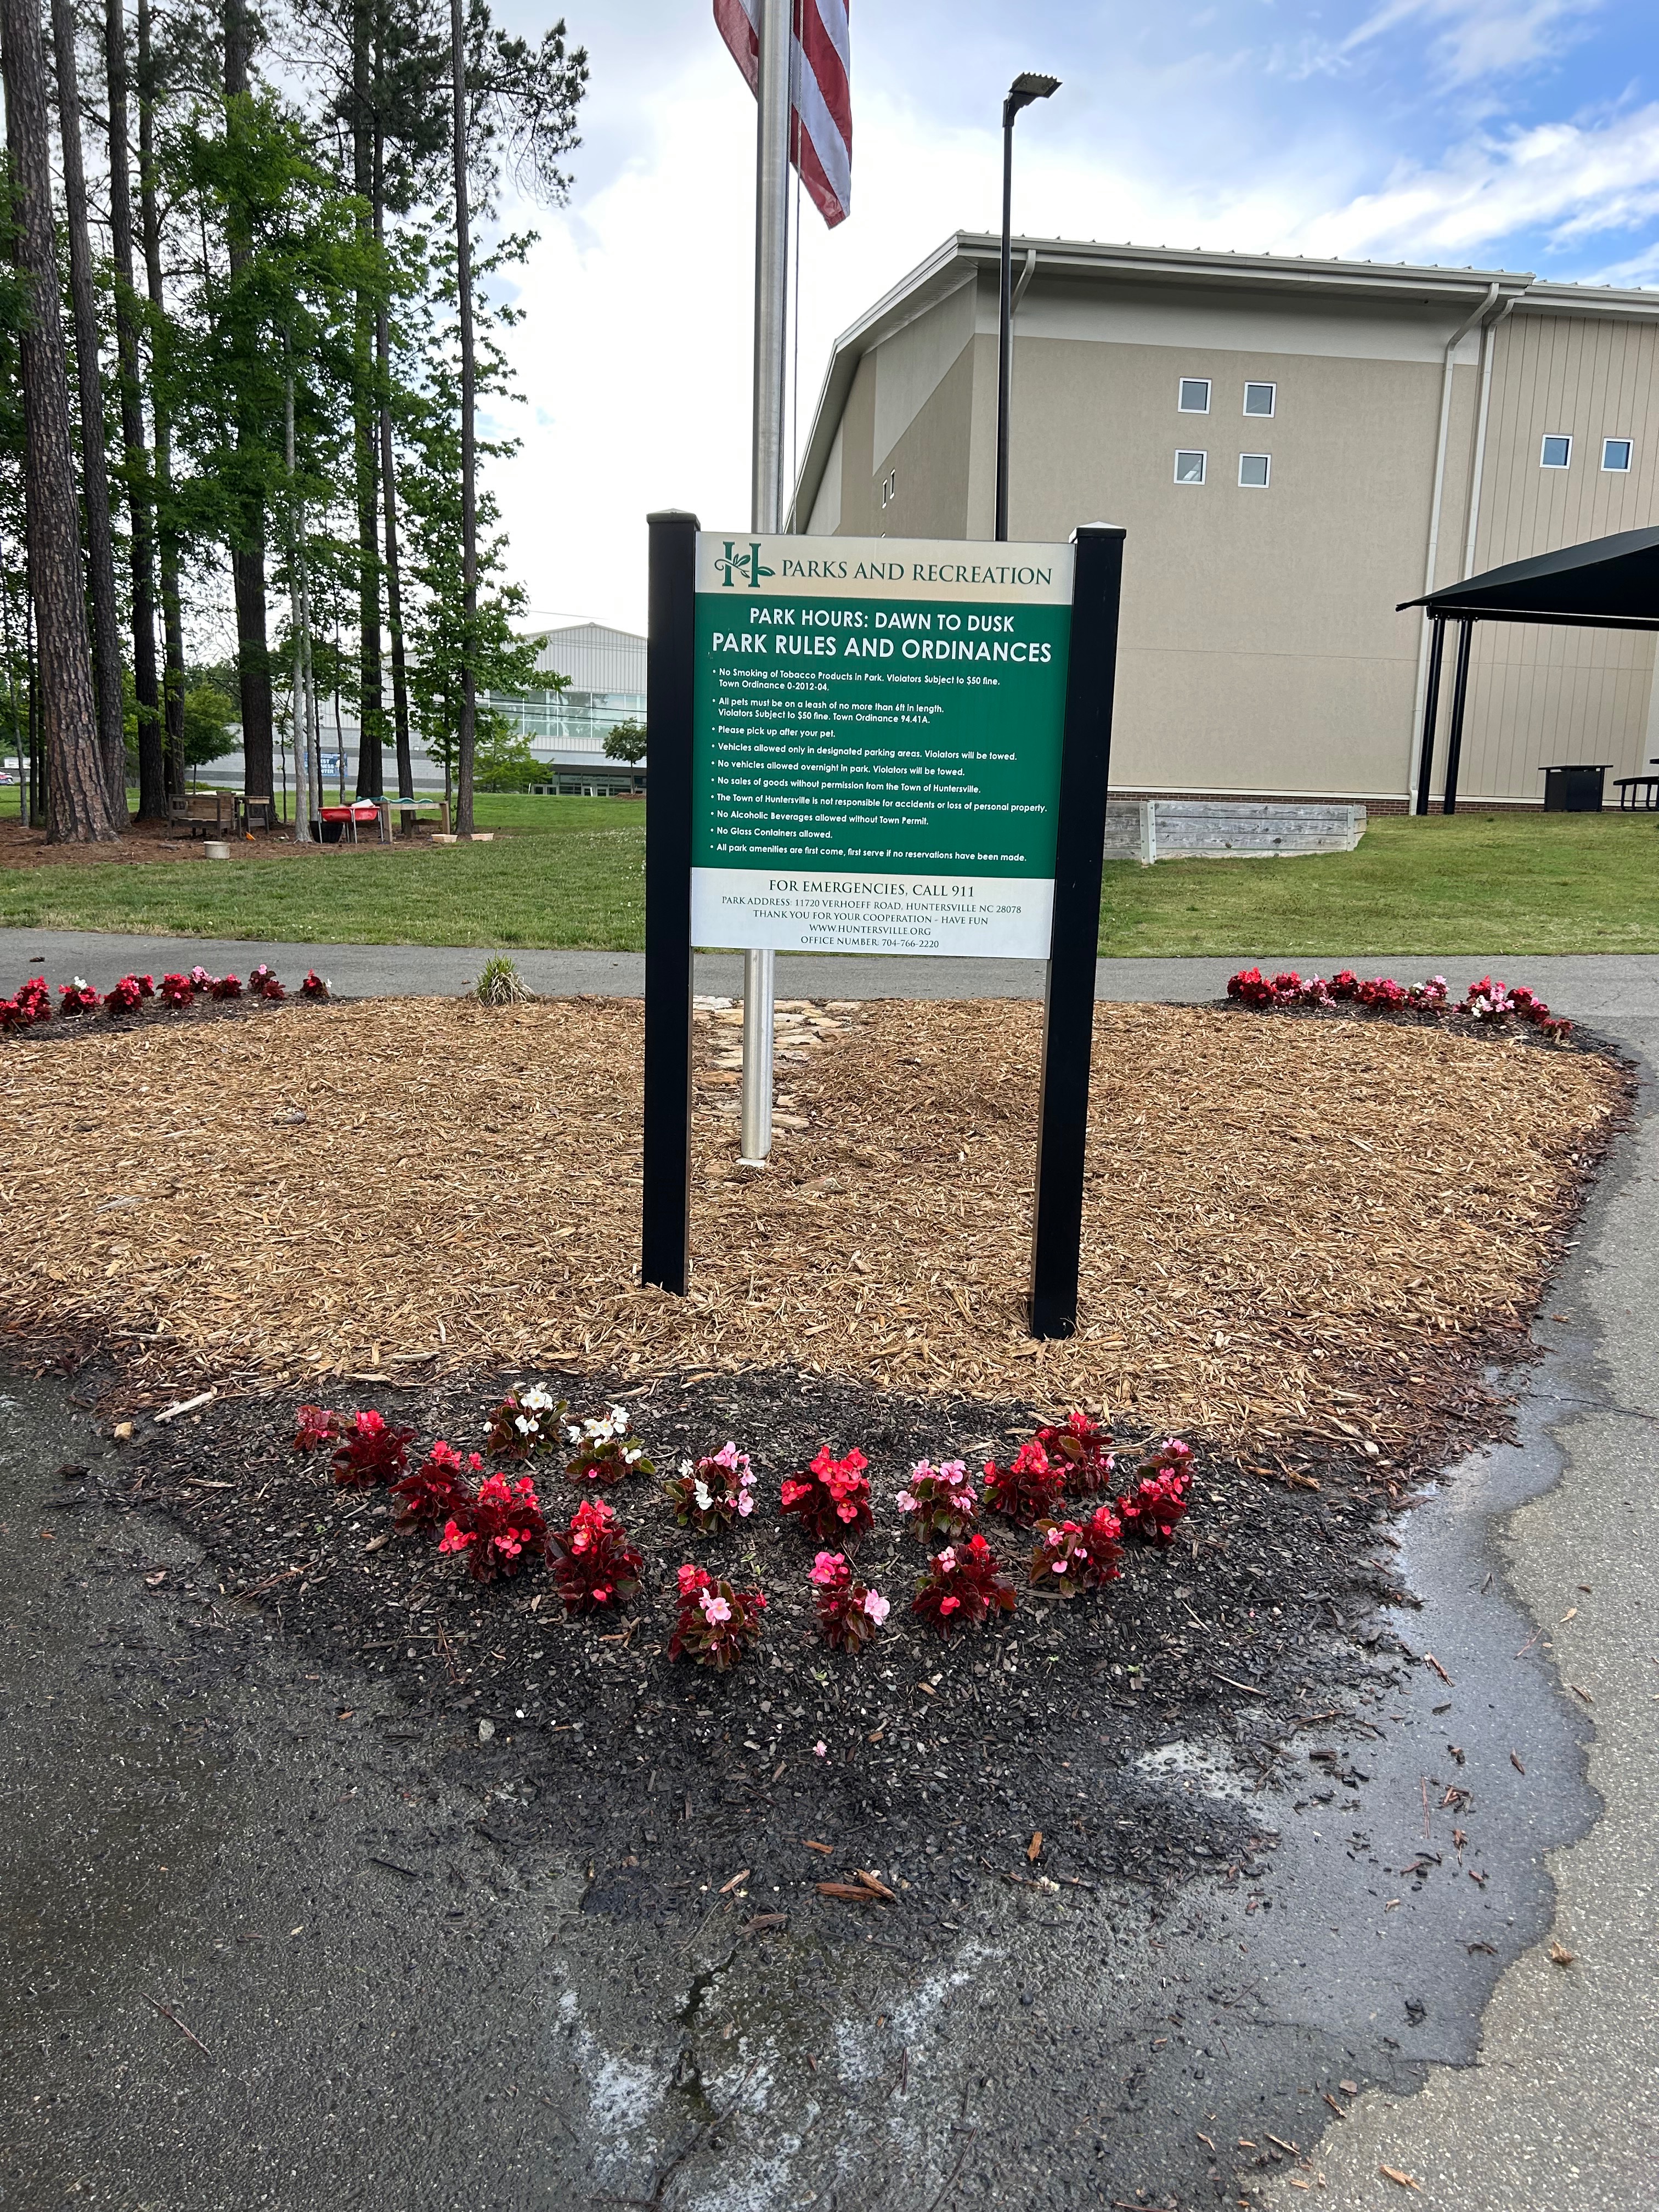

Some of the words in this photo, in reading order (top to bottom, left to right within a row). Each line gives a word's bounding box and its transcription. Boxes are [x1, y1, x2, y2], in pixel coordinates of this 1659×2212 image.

[782, 559, 848, 579] PARKS
[853, 561, 905, 580] AND
[912, 563, 1052, 585] RECREATION
[750, 607, 795, 625] PARK
[802, 609, 868, 628] HOURS:
[875, 612, 931, 630] DAWN
[937, 614, 961, 631] TO
[967, 614, 1014, 633] DUSK
[713, 632, 768, 653] PARK
[775, 634, 837, 656] RULES
[843, 637, 894, 658] AND
[901, 639, 1051, 663] ORDINANCES
[719, 668, 731, 676] No
[732, 668, 768, 679] Smoking
[770, 669, 778, 678] of
[780, 670, 816, 679] Tobacco
[818, 671, 853, 681] Products
[854, 672, 862, 681] in
[864, 673, 884, 682] Park.
[887, 674, 922, 683] Violators
[924, 675, 955, 685] Subject
[956, 675, 964, 685] to
[966, 675, 981, 686] $50
[983, 676, 1000, 685] fine.
[719, 679, 740, 688] Town
[741, 680, 786, 690] Ordinance
[718, 697, 729, 706] All
[731, 697, 748, 707] pets
[750, 698, 770, 707] must
[771, 698, 783, 707] be
[805, 700, 827, 709] leash
[828, 701, 837, 709] of
[874, 702, 893, 712] than
[895, 703, 906, 712] 6ft
[906, 703, 915, 712] in
[916, 704, 944, 714] length.
[718, 708, 753, 718] Violators
[754, 709, 786, 720] Subject
[787, 710, 796, 719] to
[797, 710, 812, 720] $50
[813, 712, 831, 720] fine.
[833, 712, 854, 721] Town
[855, 713, 899, 723] Ordinance
[901, 714, 930, 724] 94.41A.
[718, 725, 745, 734] Please
[747, 726, 765, 736] pick
[766, 729, 778, 737] up
[779, 727, 798, 736] after
[799, 730, 819, 738] your
[820, 729, 836, 739] pet.
[718, 742, 752, 752] Vehicles
[753, 743, 786, 753] allowed
[788, 745, 806, 755] only
[807, 745, 815, 754] in
[816, 746, 862, 757] designated
[864, 748, 895, 759] parking
[924, 749, 960, 759] Violators
[961, 751, 975, 759] will
[976, 751, 988, 760] be
[989, 752, 1017, 760] towed.
[718, 759, 730, 768] No
[731, 760, 765, 769] vehicles
[766, 761, 799, 770] allowed
[800, 763, 839, 774] overnight
[840, 764, 848, 772] in
[850, 764, 871, 774] park.
[873, 765, 908, 774] Violators
[909, 766, 923, 775] will
[924, 767, 935, 775] be
[937, 767, 965, 776] towed.
[717, 776, 729, 785] No
[731, 777, 752, 786] sales
[753, 777, 761, 786] of
[763, 778, 788, 788] goods
[790, 779, 820, 788] without
[821, 781, 864, 790] permission
[865, 781, 884, 790] from
[885, 782, 899, 791] the
[900, 783, 922, 792] Town
[923, 783, 932, 792] of
[933, 784, 981, 793] Huntersville.
[716, 793, 731, 802] The
[732, 793, 753, 803] Town
[755, 794, 764, 803] of
[765, 794, 811, 804] Huntersville
[812, 796, 818, 805] is
[820, 797, 834, 805] not
[834, 798, 881, 808] responsible
[882, 798, 894, 807] for
[894, 800, 935, 809] accidents
[946, 801, 962, 810] loss
[963, 802, 973, 810] of
[973, 803, 1009, 812] personal
[1011, 804, 1047, 814] property.
[716, 810, 729, 818] No
[730, 810, 769, 820] Alcoholic
[770, 812, 813, 822] Beverages
[814, 813, 847, 822] allowed
[849, 815, 878, 823] without
[879, 816, 900, 825] Town
[901, 816, 929, 825] Permit.
[716, 826, 729, 835] No
[730, 827, 752, 836] Glass
[754, 828, 797, 837] Containers
[798, 830, 833, 839] allowed.
[716, 843, 727, 851] All
[728, 844, 747, 853] park
[748, 845, 788, 854] amenities
[804, 846, 819, 855] first
[820, 848, 846, 857] come,
[847, 848, 862, 856] first
[886, 849, 891, 857] if
[905, 850, 953, 859] reservations
[955, 851, 976, 860] have
[977, 851, 999, 861] been
[1000, 853, 1027, 862] made.
[770, 879, 799, 891] FOR
[803, 881, 908, 896] EMERGENCIES,
[912, 884, 948, 896] CALL
[952, 885, 973, 898] 911
[722, 896, 746, 905] PARK
[746, 897, 793, 906] ADDRESS:
[795, 899, 820, 907] 11720
[822, 900, 871, 909] VERHOEFF
[873, 901, 903, 911] ROAD,
[906, 902, 977, 912] HUNTERSVILLE
[979, 905, 994, 913] NC
[996, 905, 1022, 914] 28078
[753, 909, 788, 918] THANK
[789, 911, 810, 919] YOU
[812, 911, 832, 920] FOR
[833, 912, 861, 921] YOUR
[862, 913, 932, 923] COOPERATION
[941, 916, 966, 924] HAVE
[968, 917, 989, 925] FUN
[809, 924, 931, 936] WWW.HUNTERSVILLE.ORG
[800, 935, 834, 945] OFFICE
[882, 939, 939, 949] 704-766-2220
